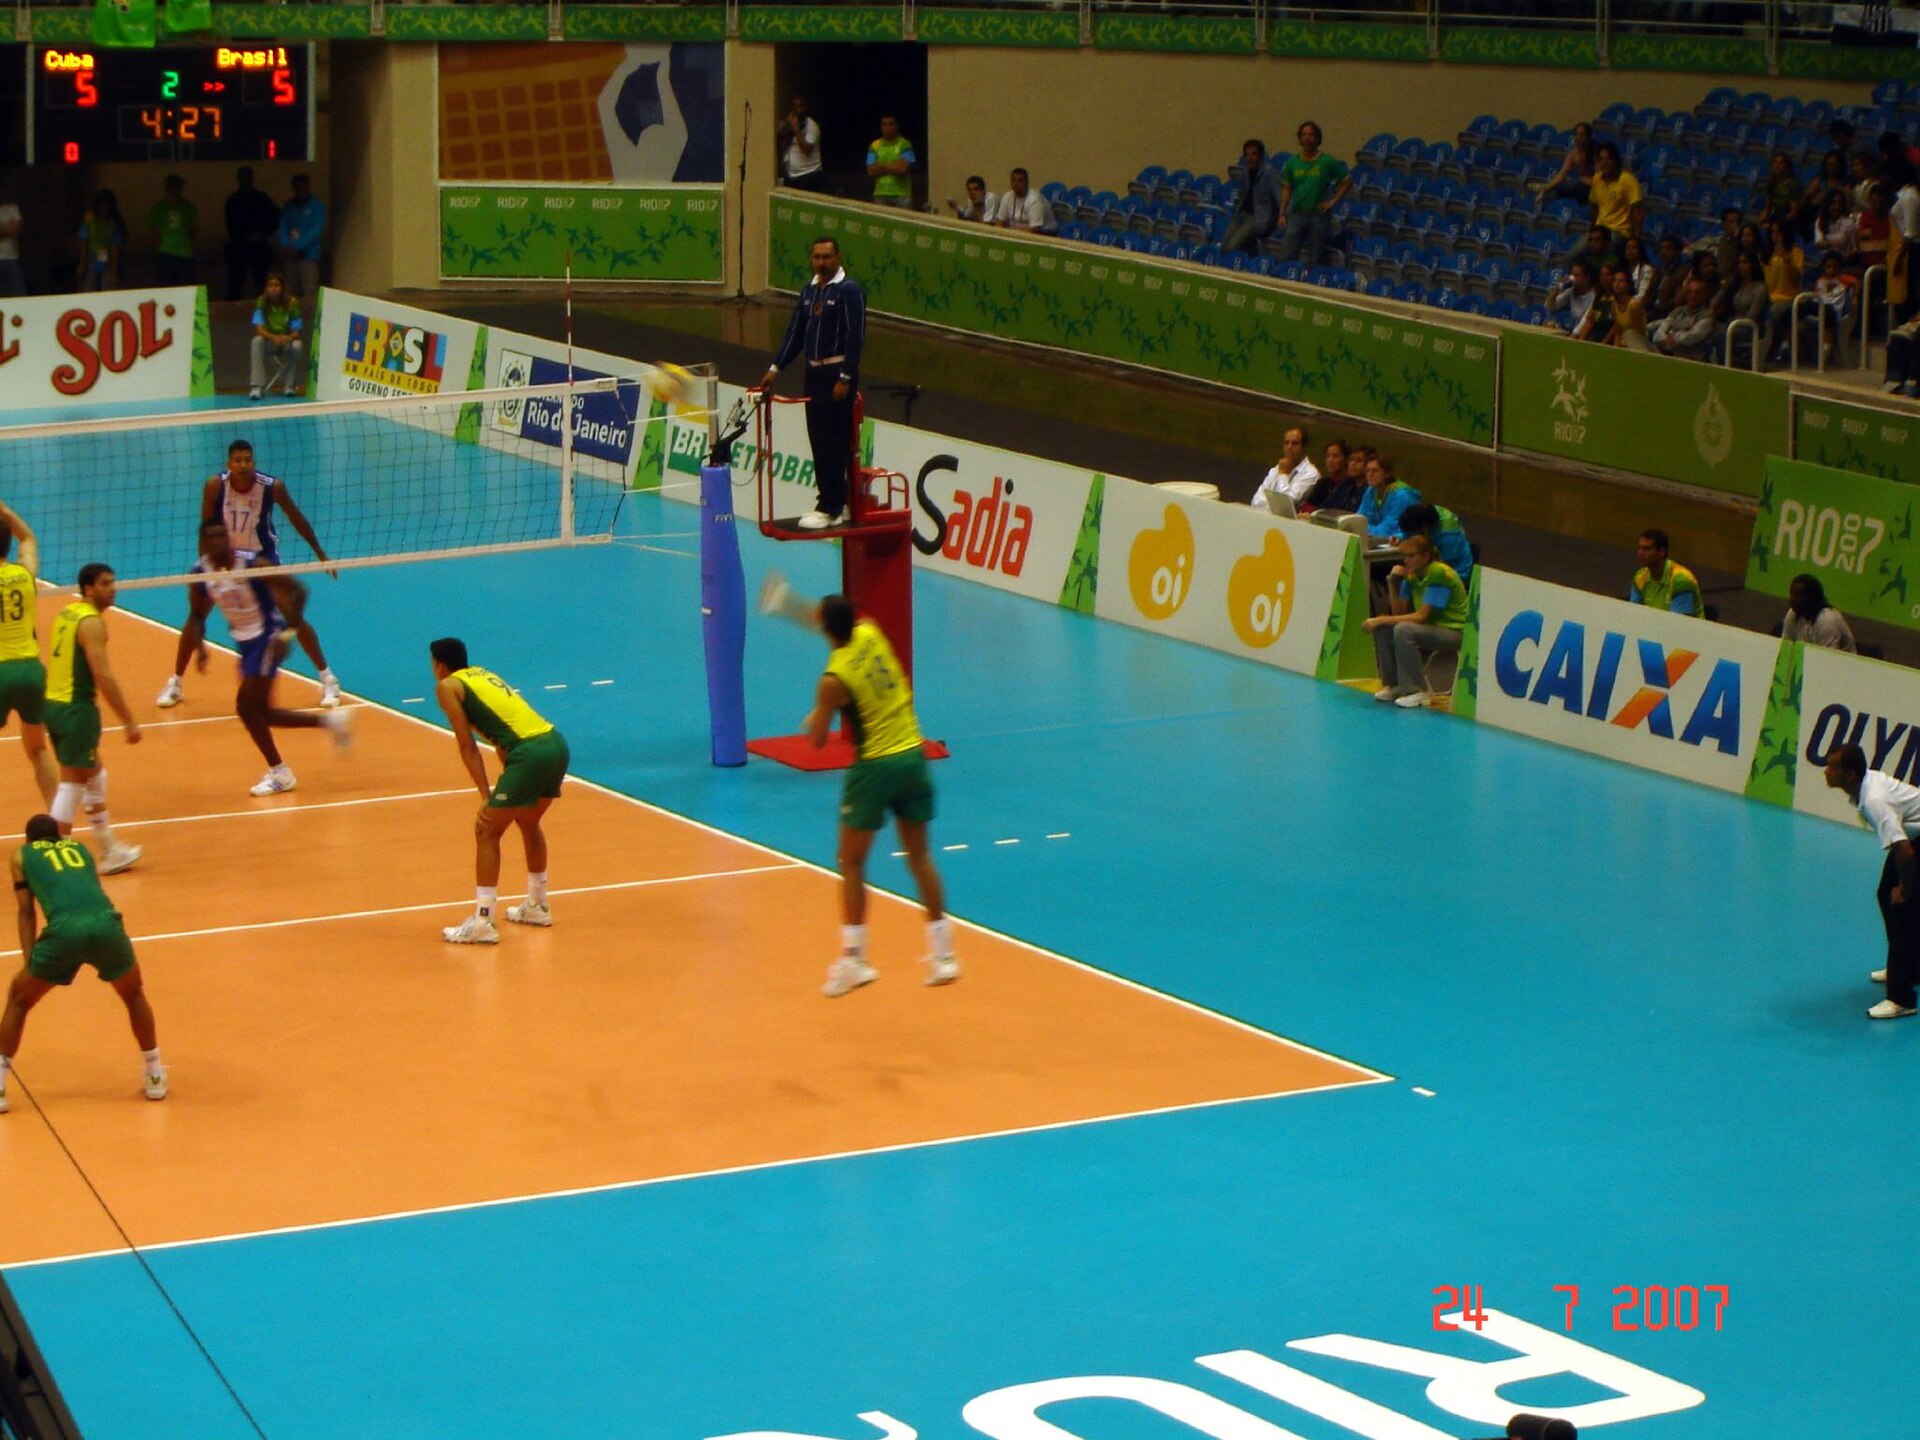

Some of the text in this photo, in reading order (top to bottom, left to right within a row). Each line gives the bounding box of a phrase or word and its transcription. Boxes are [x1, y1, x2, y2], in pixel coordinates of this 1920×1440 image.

[45, 50, 95, 69] Cuba
[217, 47, 288, 67] Brasil
[75, 70, 97, 107] 5
[162, 71, 179, 98] 2
[272, 68, 295, 104] 5
[141, 107, 222, 140] 4:27
[346, 312, 447, 382] BRASIL
[349, 378, 389, 398] GOVERNO
[390, 375, 401, 386] DE
[407, 379, 439, 393] TODOS
[527, 400, 549, 428] Rio
[572, 413, 626, 449] Janeiro
[230, 510, 250, 532] 17
[911, 455, 1033, 577] Sadia
[1151, 555, 1186, 608] oi
[1250, 581, 1287, 637] oi
[1495, 609, 1742, 757] CAIXA
[44, 847, 85, 871] 10
